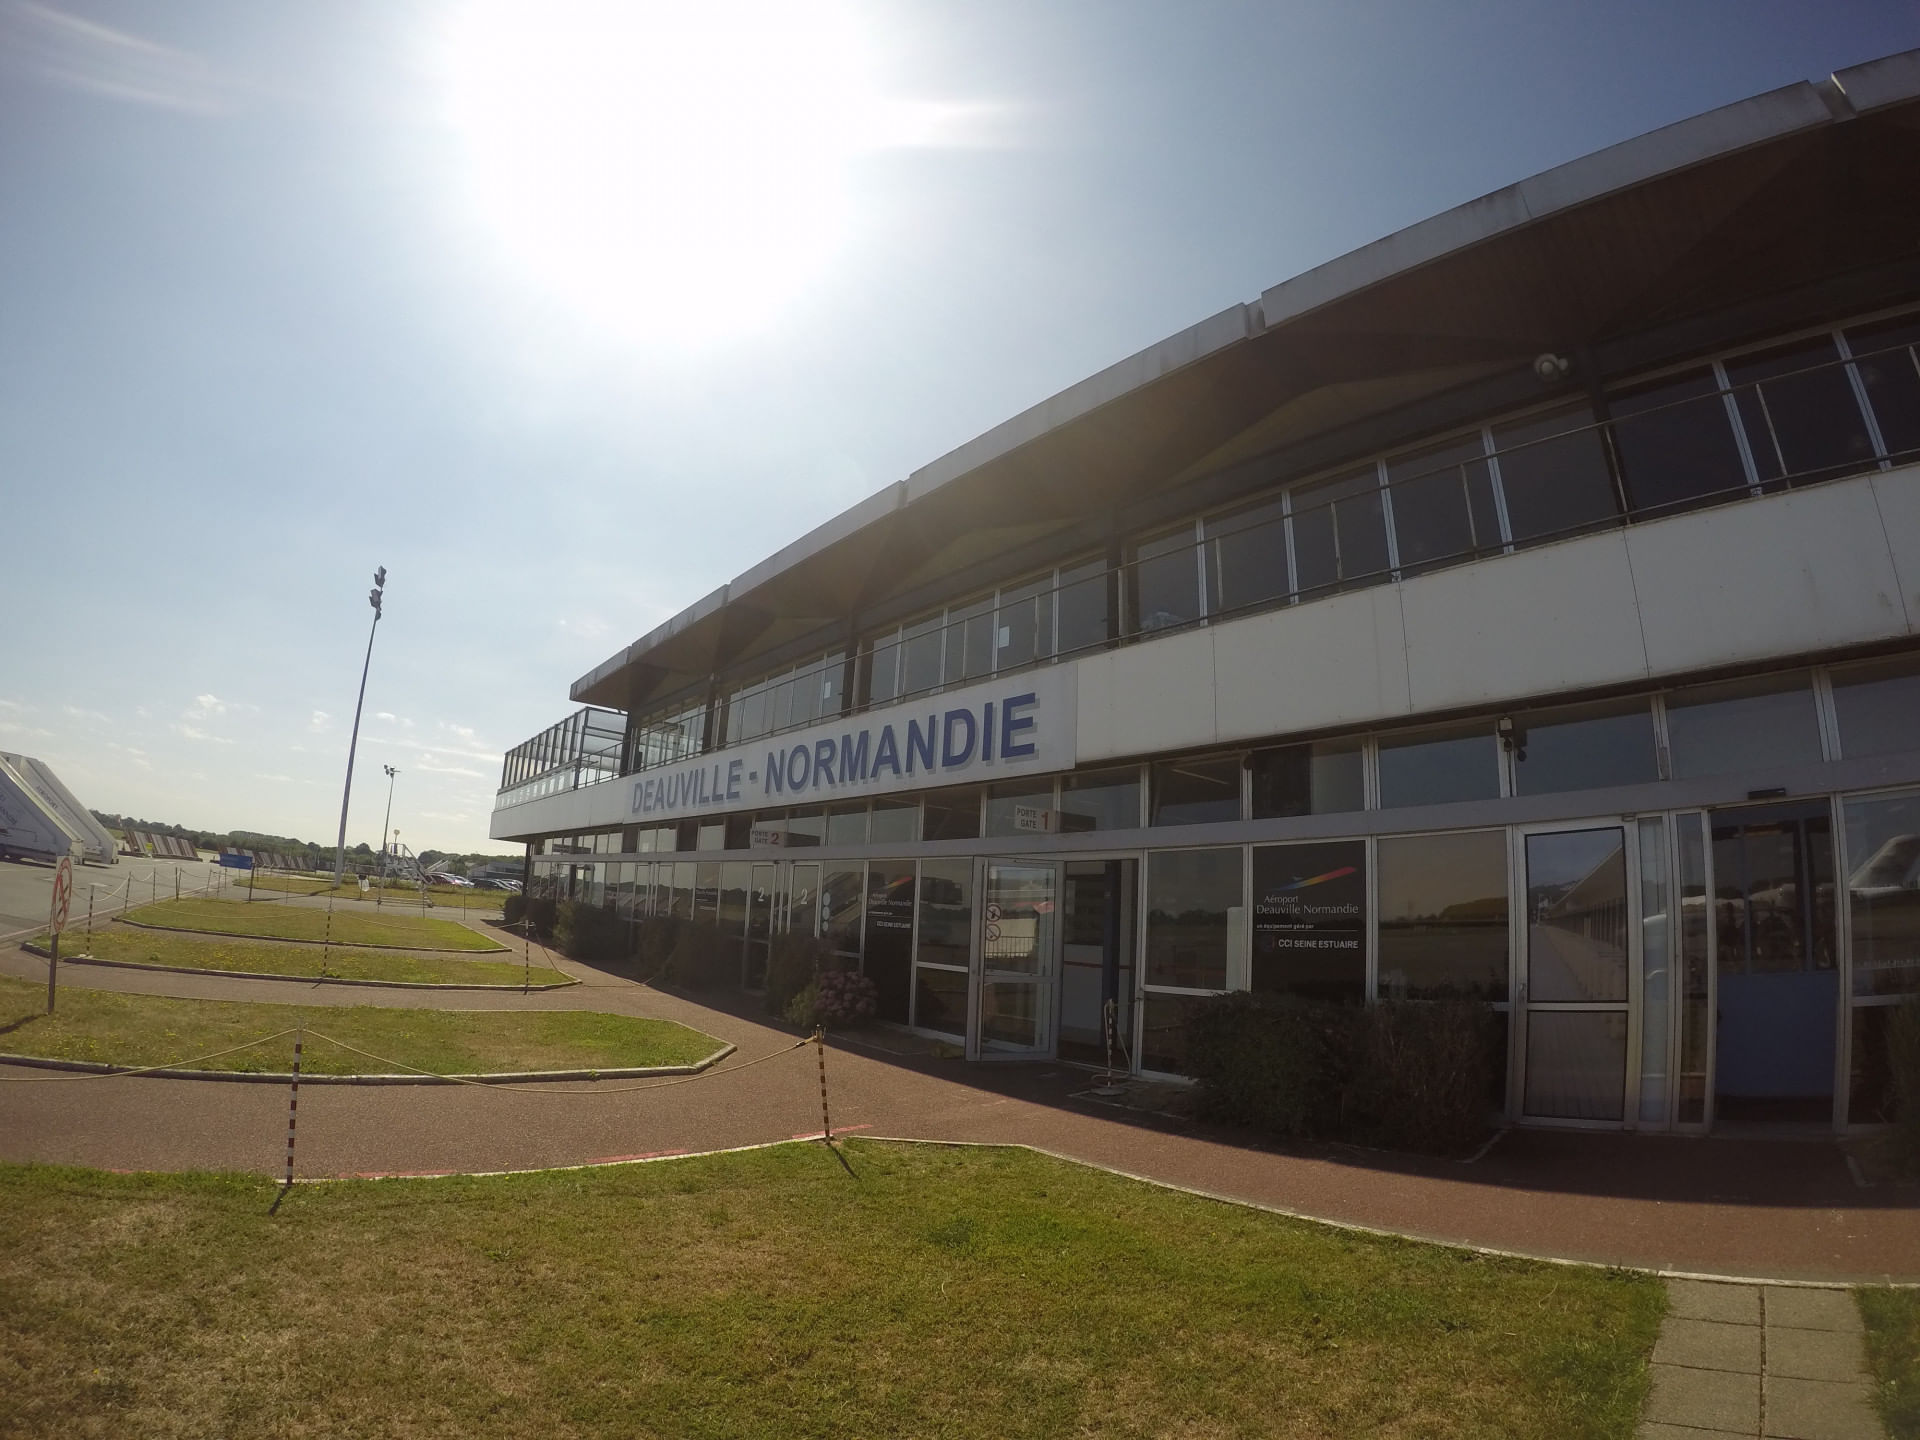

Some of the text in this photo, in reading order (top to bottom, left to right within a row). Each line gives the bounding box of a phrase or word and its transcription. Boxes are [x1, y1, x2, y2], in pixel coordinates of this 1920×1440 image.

[631, 759, 743, 815] DEAUVILLE
[764, 692, 1038, 795] NORMANDIE
[1017, 808, 1037, 818] PORTE
[1020, 819, 1037, 829] GATE
[1041, 811, 1049, 830] 1
[771, 832, 779, 845] 2
[758, 887, 764, 902] 2
[800, 888, 808, 905] 2
[1264, 895, 1298, 905] Aéroport
[1256, 903, 1359, 914] Deauville Normandie
[1278, 939, 1359, 949] CCI SEINE ESTUAIRE
